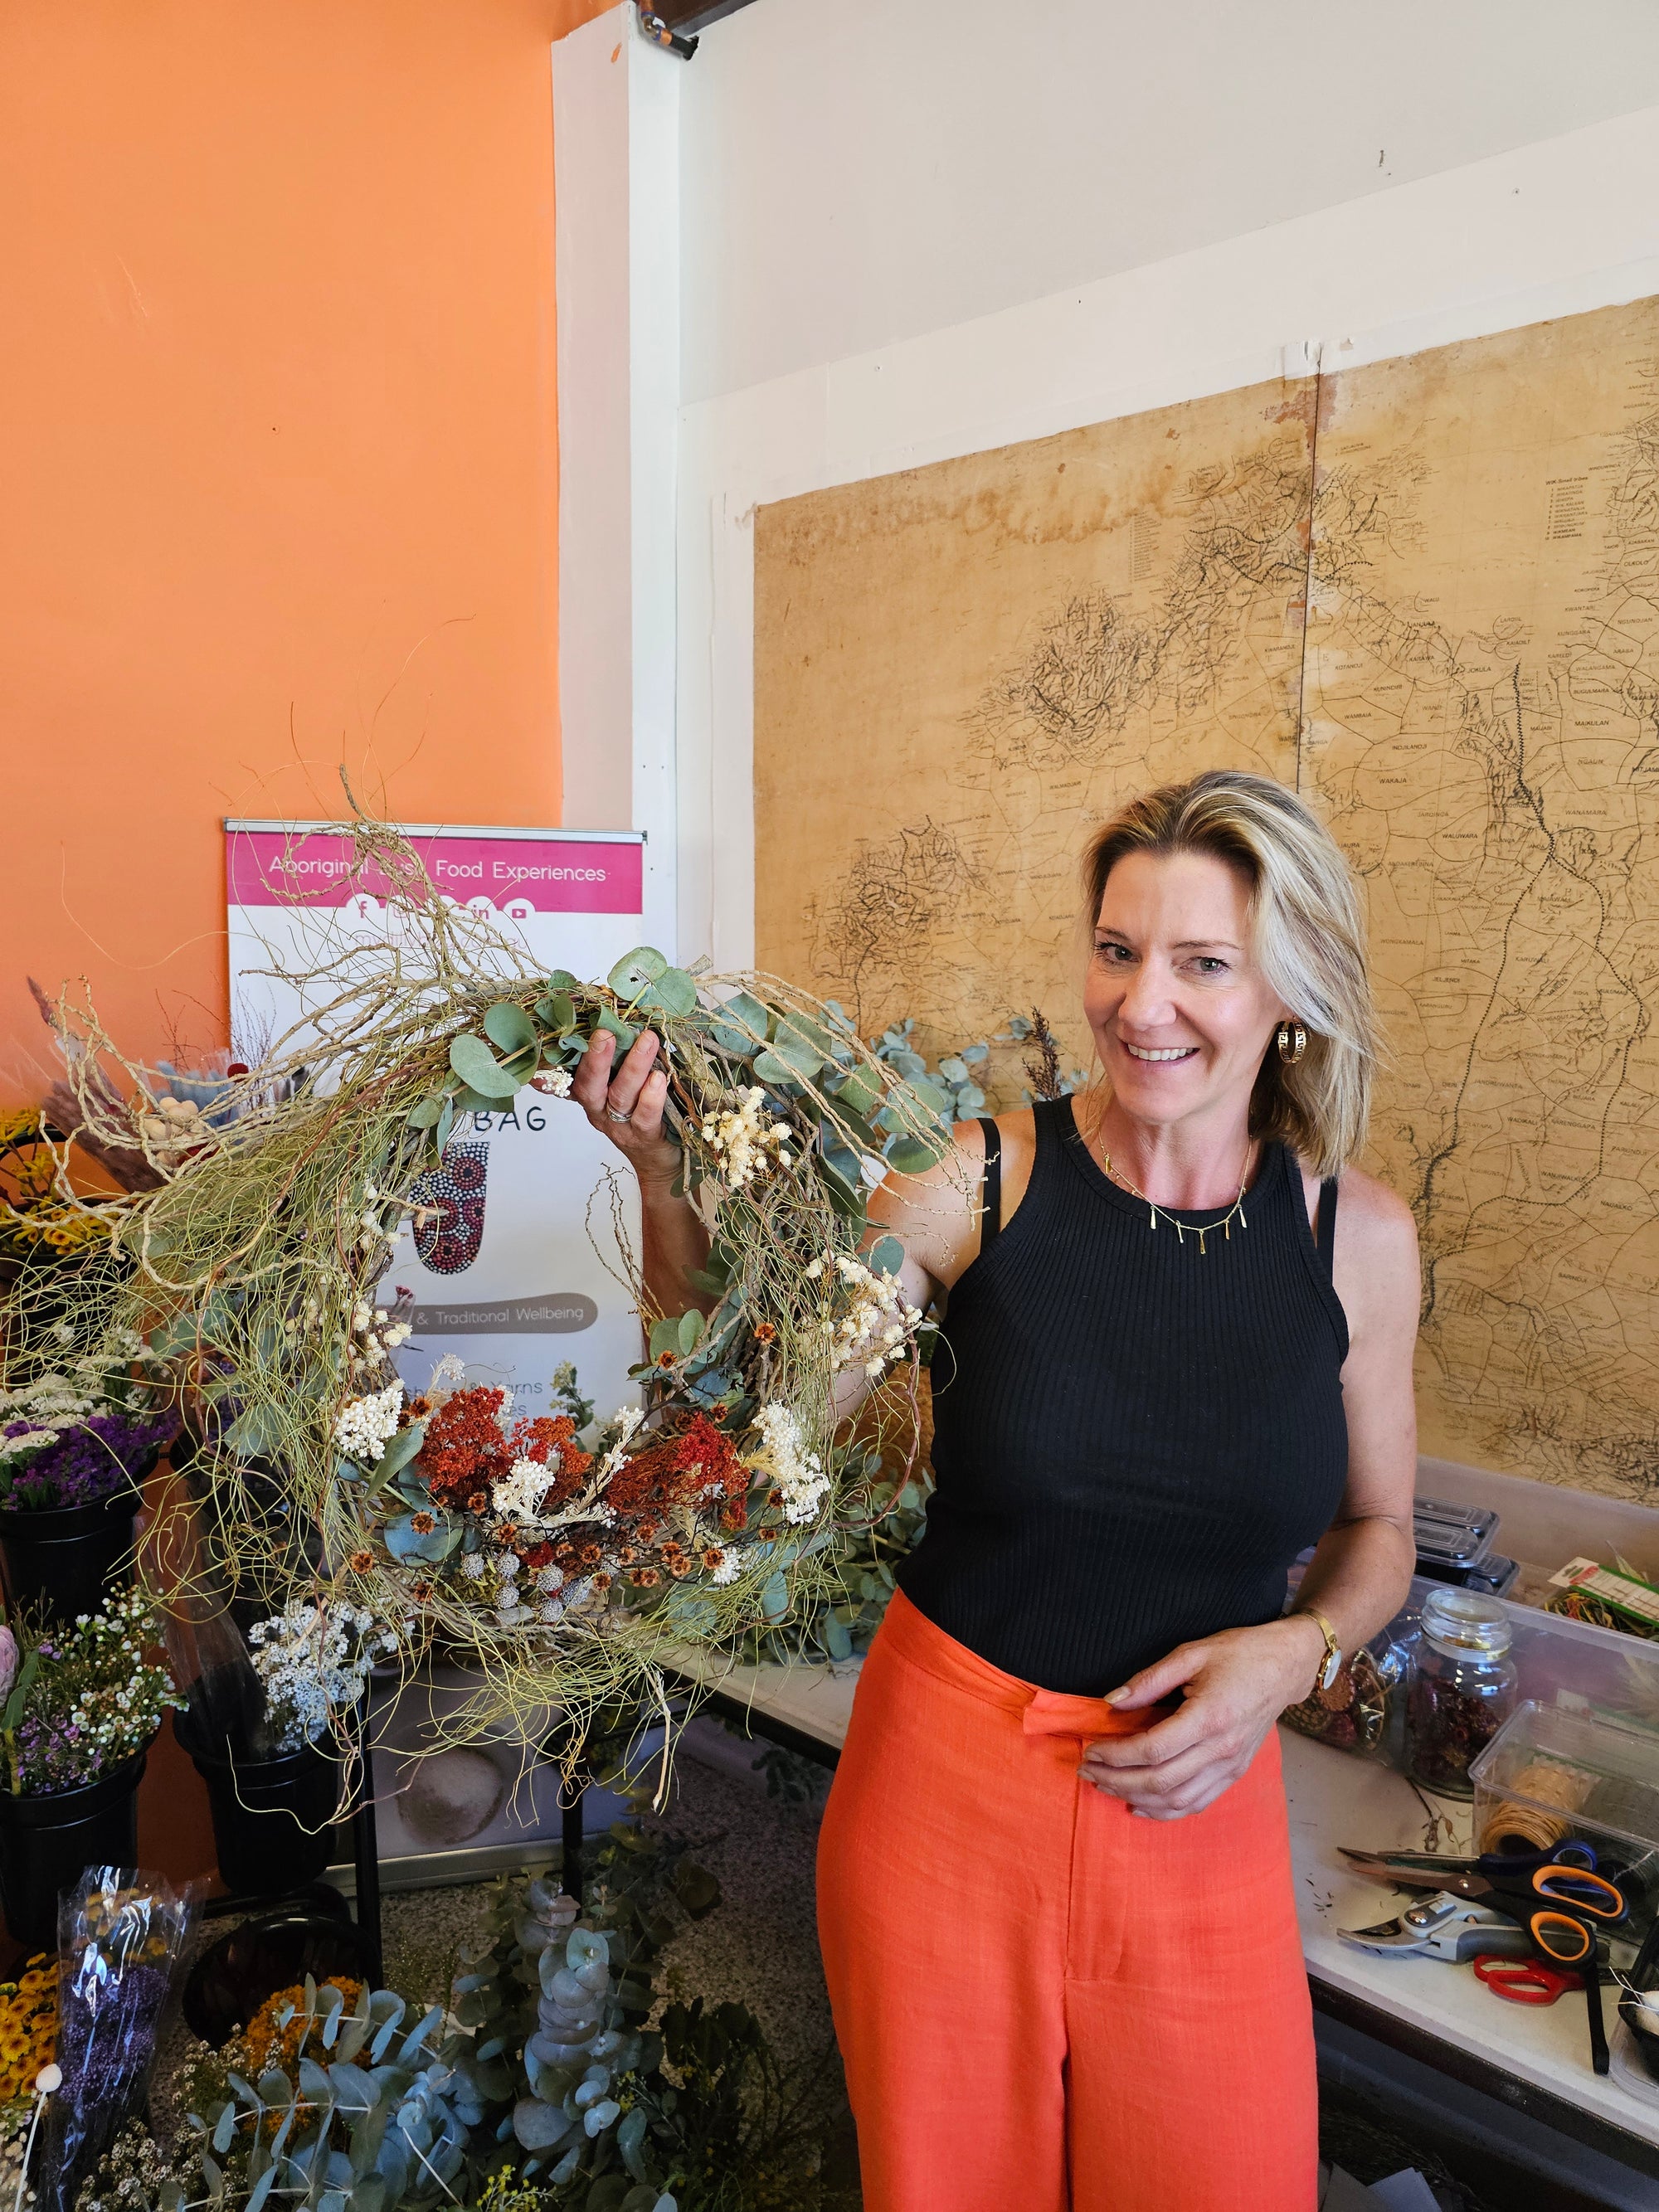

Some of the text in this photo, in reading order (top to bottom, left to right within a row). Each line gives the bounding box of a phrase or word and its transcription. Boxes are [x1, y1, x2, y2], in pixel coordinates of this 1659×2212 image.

[435, 859, 483, 878] Food
[492, 861, 606, 882] Experiences
[474, 1106, 546, 1132] BAG
[417, 1305, 584, 1325] & Traditional Wellbeing
